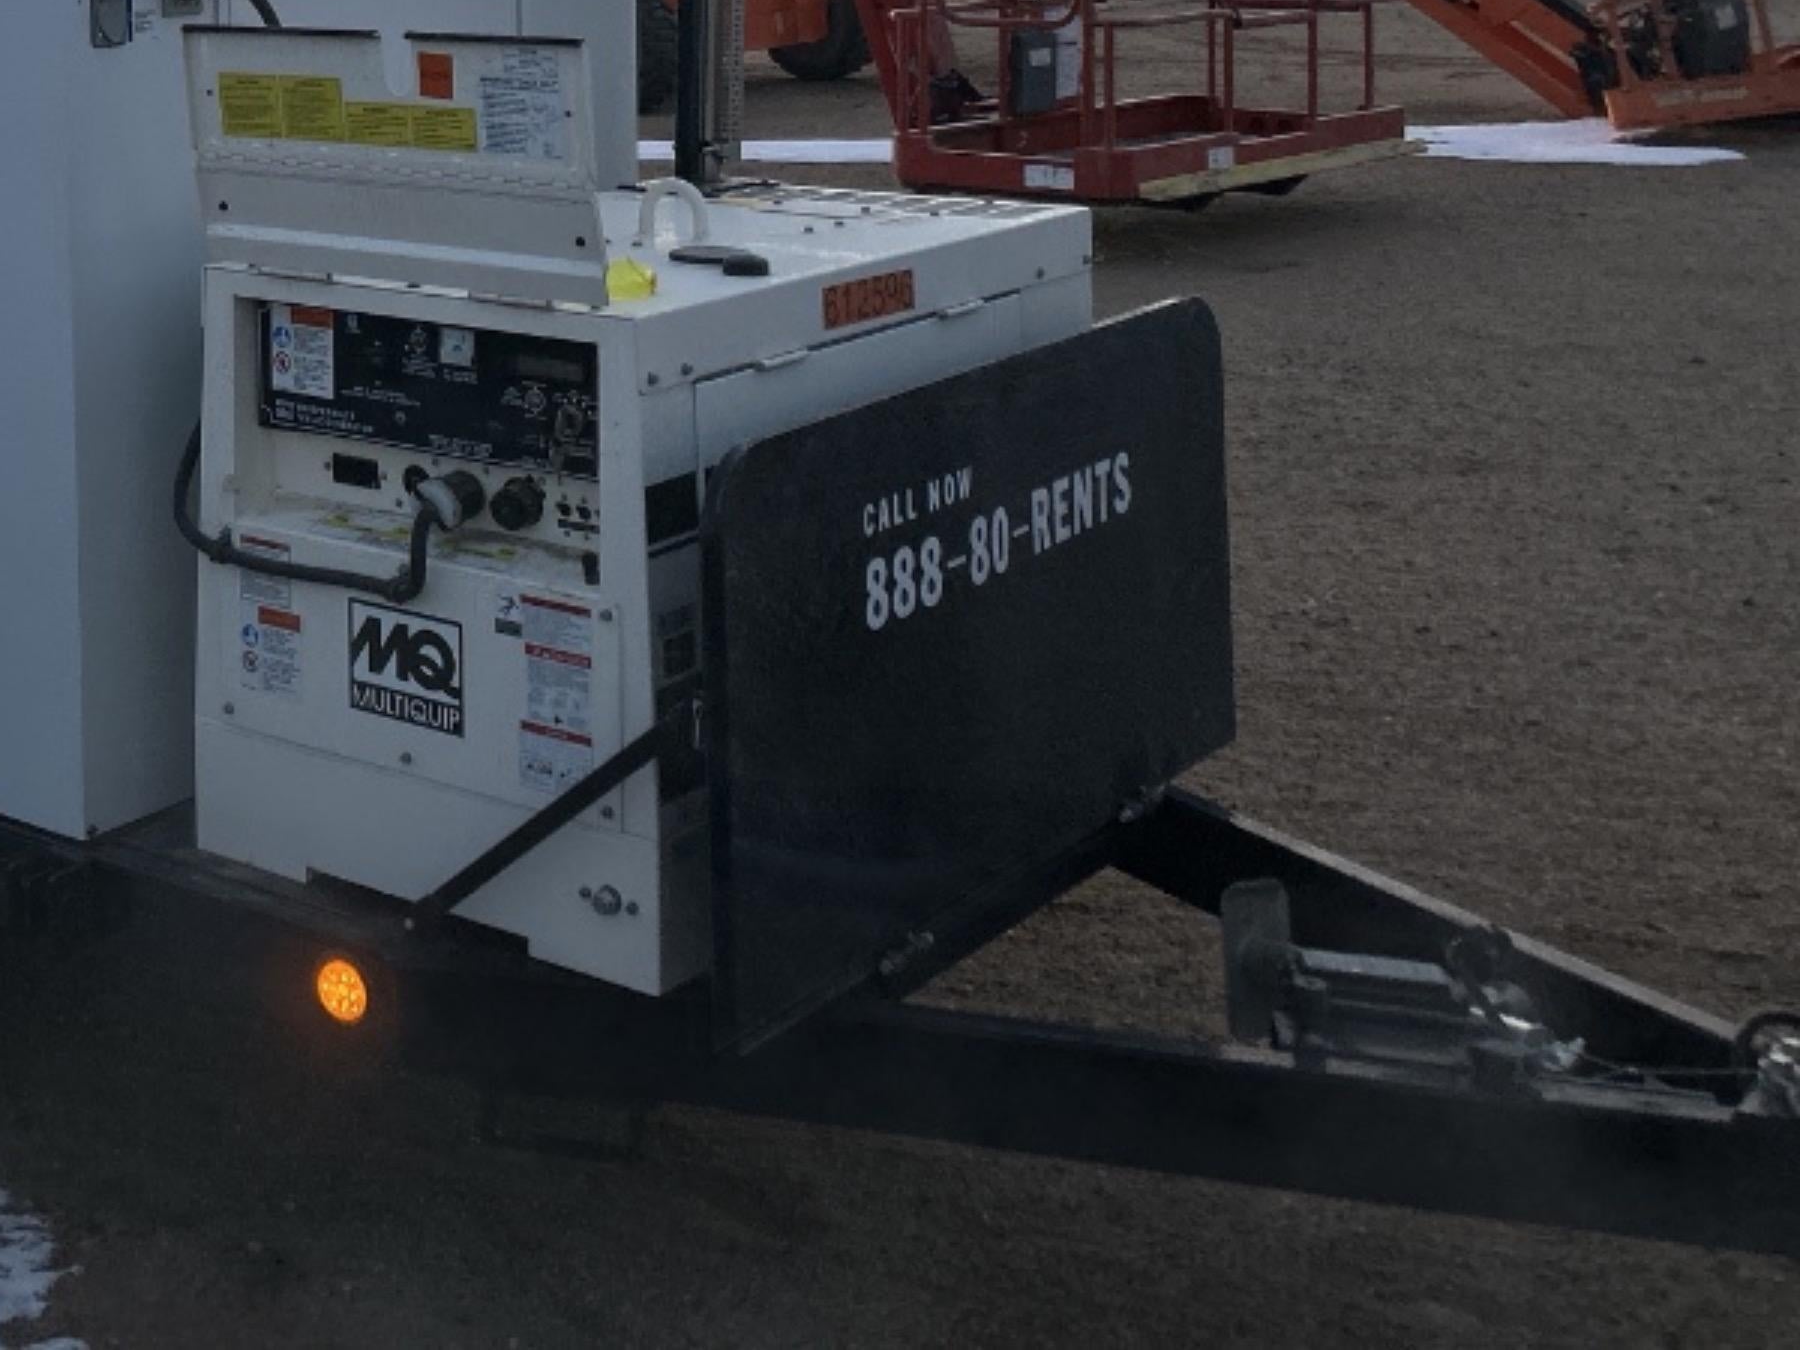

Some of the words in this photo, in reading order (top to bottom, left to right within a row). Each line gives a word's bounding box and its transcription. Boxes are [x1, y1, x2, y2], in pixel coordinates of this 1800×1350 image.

[823, 270, 915, 329] 612596
[863, 488, 917, 538] CALL
[928, 465, 973, 513] NOW
[865, 451, 1133, 631] 888-80-RENTS
[351, 614, 462, 700] MQ
[352, 683, 461, 731] MULTIQUIP
